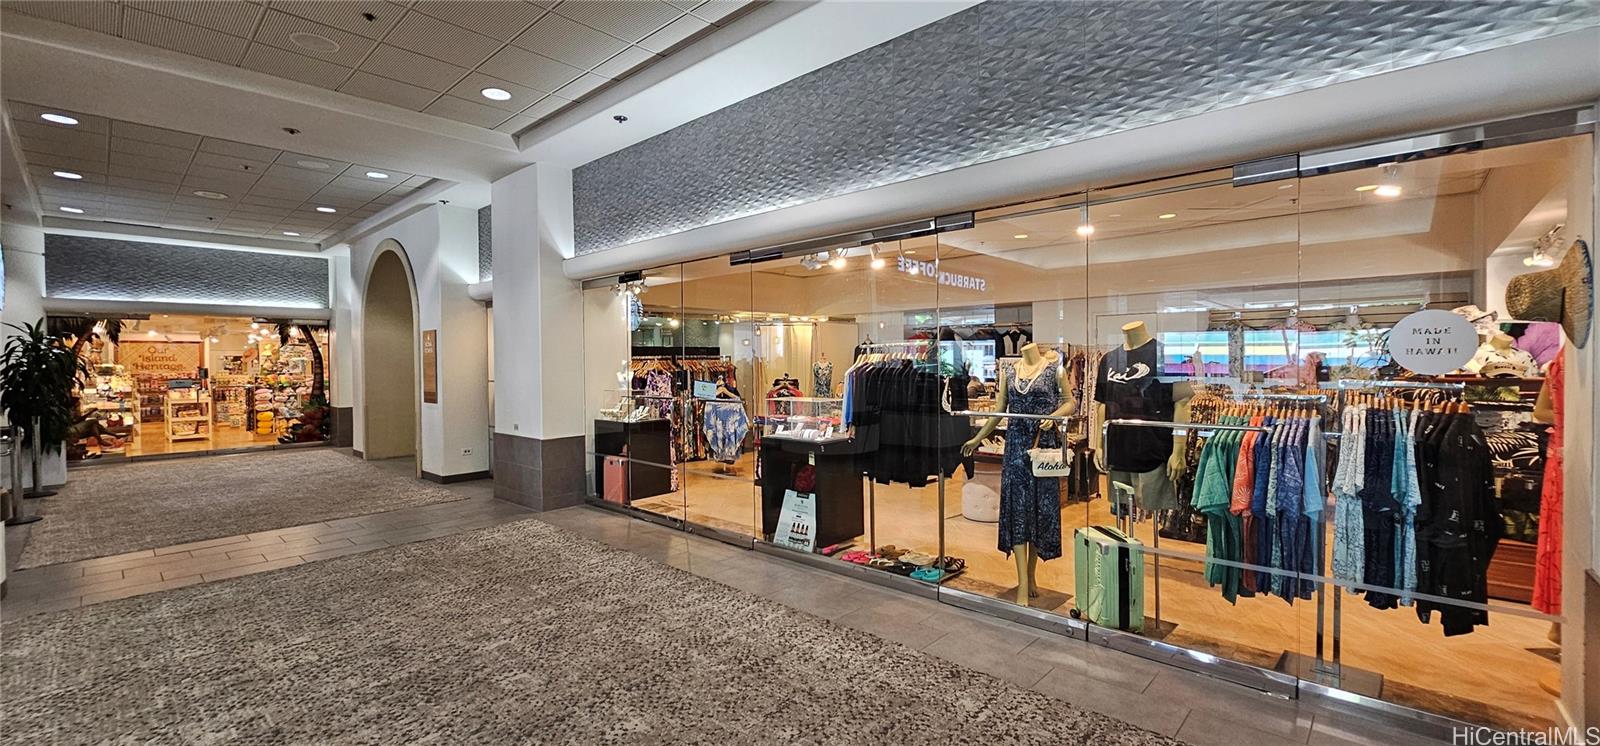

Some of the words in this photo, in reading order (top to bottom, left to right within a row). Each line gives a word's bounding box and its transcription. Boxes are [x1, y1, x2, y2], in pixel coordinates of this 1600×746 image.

[1412, 327, 1452, 335] MADE
[1426, 337, 1441, 345] IN
[147, 345, 169, 354] Our
[138, 354, 177, 362] Island
[132, 362, 185, 371] Heritage
[1037, 461, 1067, 471] Aloha
